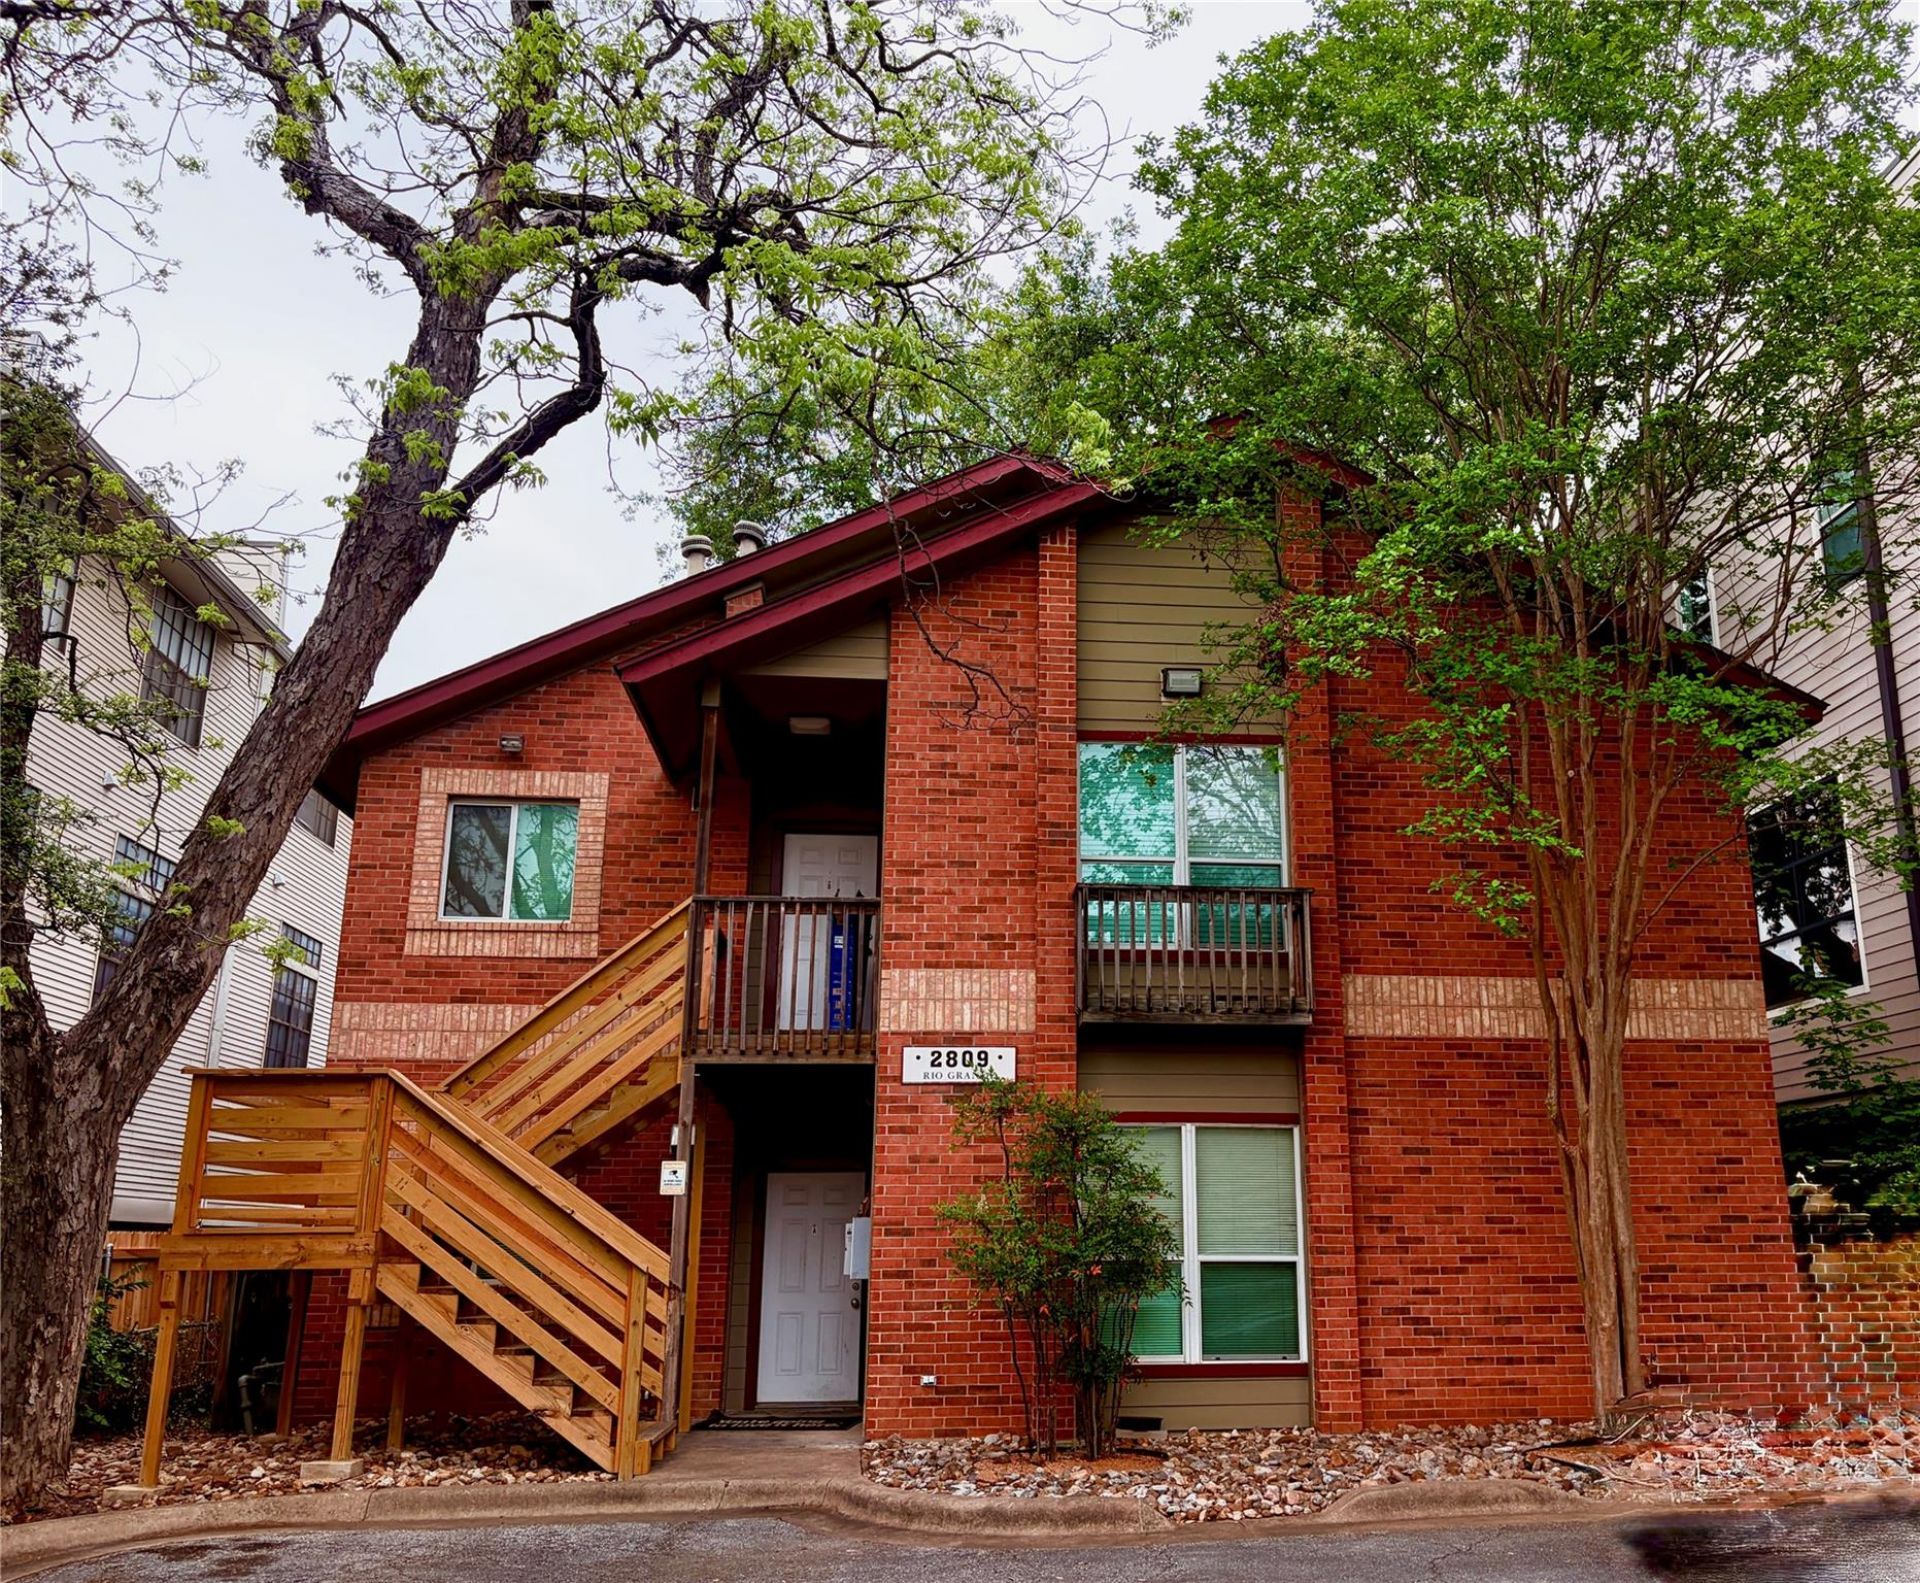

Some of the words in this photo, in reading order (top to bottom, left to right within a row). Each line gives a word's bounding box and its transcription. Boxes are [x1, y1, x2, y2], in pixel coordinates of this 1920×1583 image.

[930, 1050, 988, 1068] 2809
[923, 1071, 943, 1080] RIO
[947, 1071, 990, 1080] GRA
